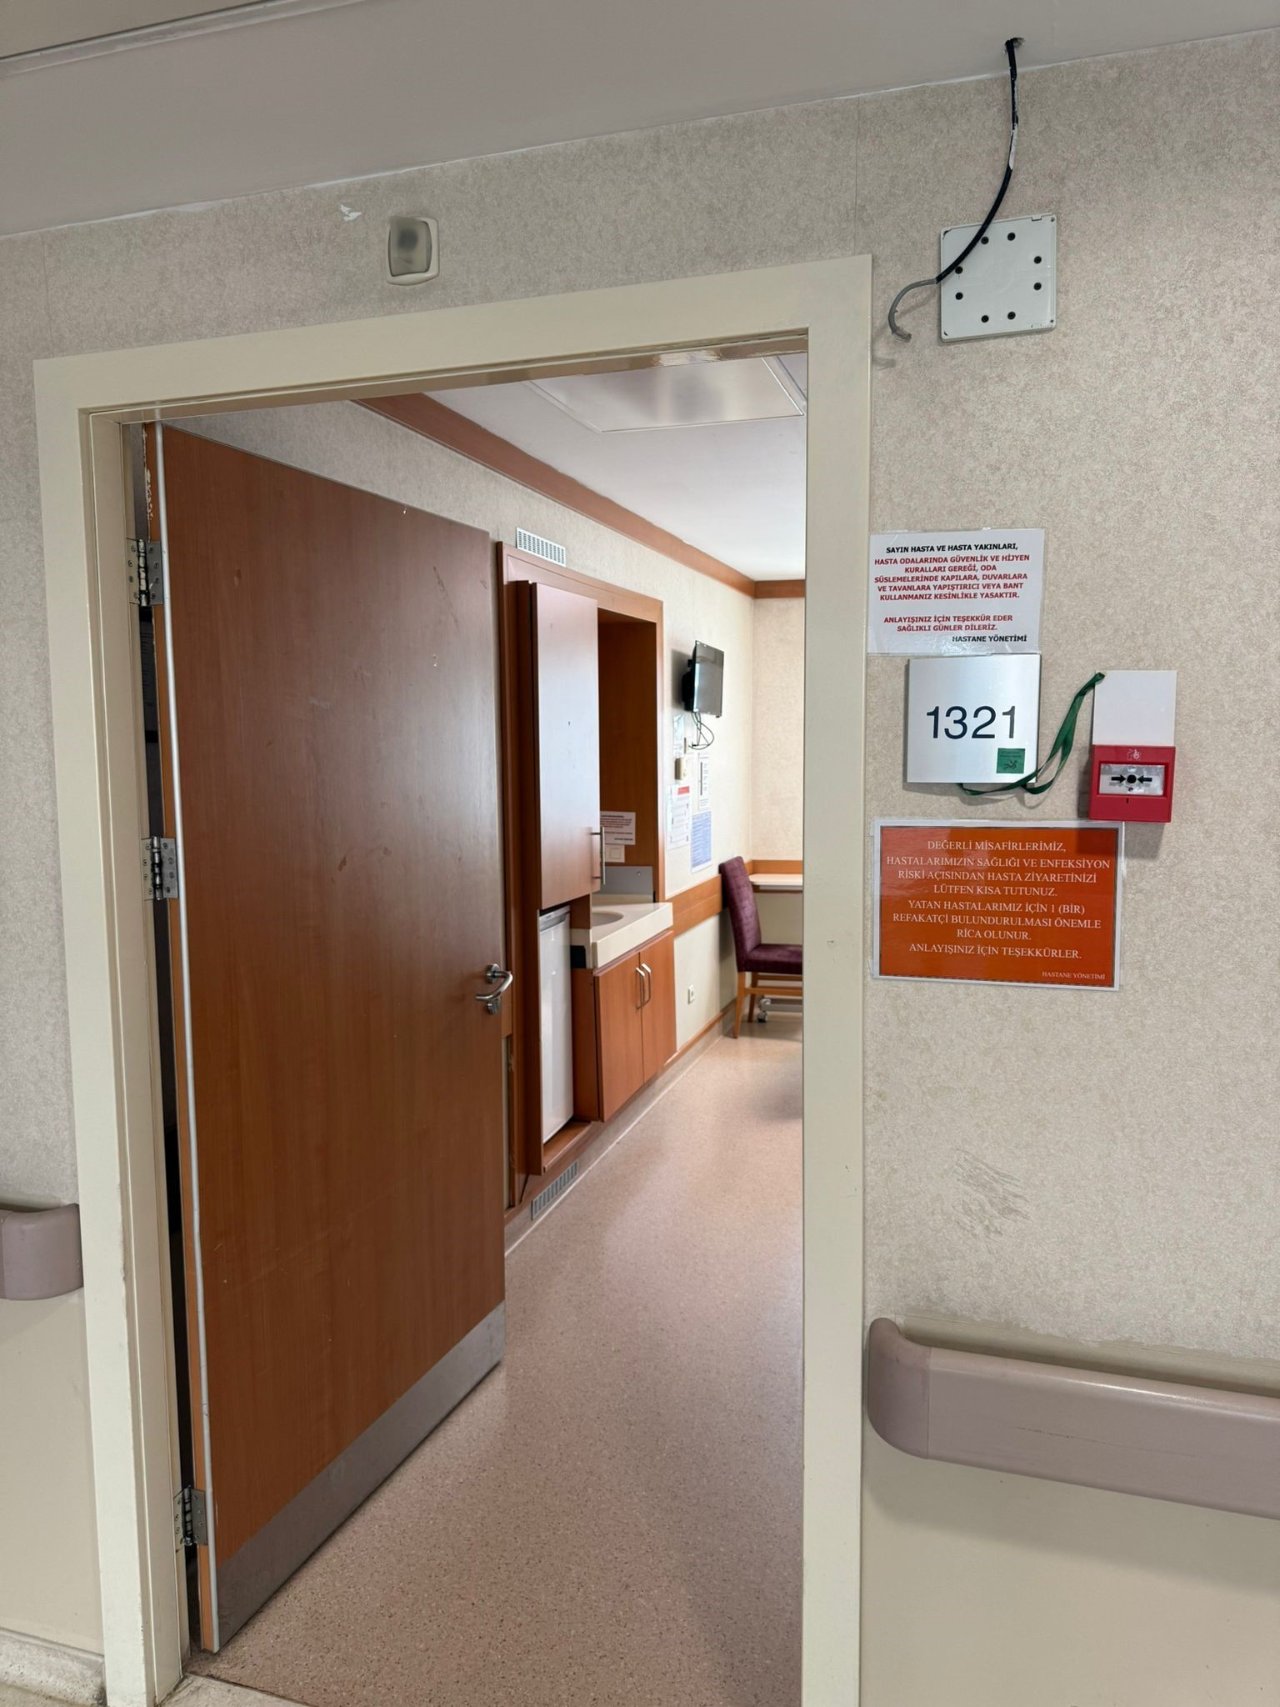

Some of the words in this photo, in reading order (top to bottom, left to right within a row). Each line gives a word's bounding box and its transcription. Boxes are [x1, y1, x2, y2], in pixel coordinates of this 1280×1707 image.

[950, 554, 988, 563] GÜVENLİK
[1001, 553, 1030, 562] HİJYEN
[948, 564, 978, 572] GEREĞİ,
[875, 574, 938, 583] SÜSLEMELERİNDE
[933, 583, 979, 591] YAPIŞTIRICI
[934, 591, 977, 599] KESİNLİKLE
[884, 616, 931, 624] ANLAYIŞINIZ
[933, 615, 950, 623] İÇİN
[953, 614, 991, 622] TEŞEKKÜR
[897, 624, 931, 632] SAĞLIKLI
[933, 623, 962, 631] GÜNLER
[965, 622, 997, 630] DİLERİZ.
[988, 634, 1027, 642] YÖNETİMİ
[926, 706, 1016, 740] 1321
[927, 840, 972, 850] DEĞERLİ
[975, 841, 1066, 852] MİSAFİRLERİMİZ,
[887, 856, 974, 866] HASTALARIMIZIN
[977, 857, 1020, 868] SAĞLIĞI
[1023, 859, 1038, 868] VE
[1040, 858, 1110, 869] ENFEKSİYON
[898, 870, 925, 879] RİSKİ
[927, 872, 985, 882] AÇISINDAN
[987, 873, 1021, 882] HASTA
[1024, 873, 1097, 883] ZİYARETİNİZİ
[934, 884, 974, 894] LÜTFEN
[976, 886, 1001, 895] KISA
[1004, 888, 1057, 896] TUTUNUZ.
[909, 900, 941, 909] YATAN
[944, 901, 1022, 912] HASTALARIMIZ
[1025, 901, 1048, 914] İÇİN
[1051, 904, 1055, 912] 1
[1058, 904, 1085, 915] (BİR)
[893, 913, 949, 924] REFAKATÇİ
[951, 915, 1051, 926] BULUNDURULMASI
[1054, 918, 1101, 929] ÖNEMLE
[957, 928, 981, 938] RİCA
[984, 931, 1031, 940] OLUNUR.
[909, 943, 974, 955] ANLAYIŞINIZ
[977, 945, 999, 956] İÇİN
[1002, 947, 1082, 959] TEŞEKKÜRLER.
